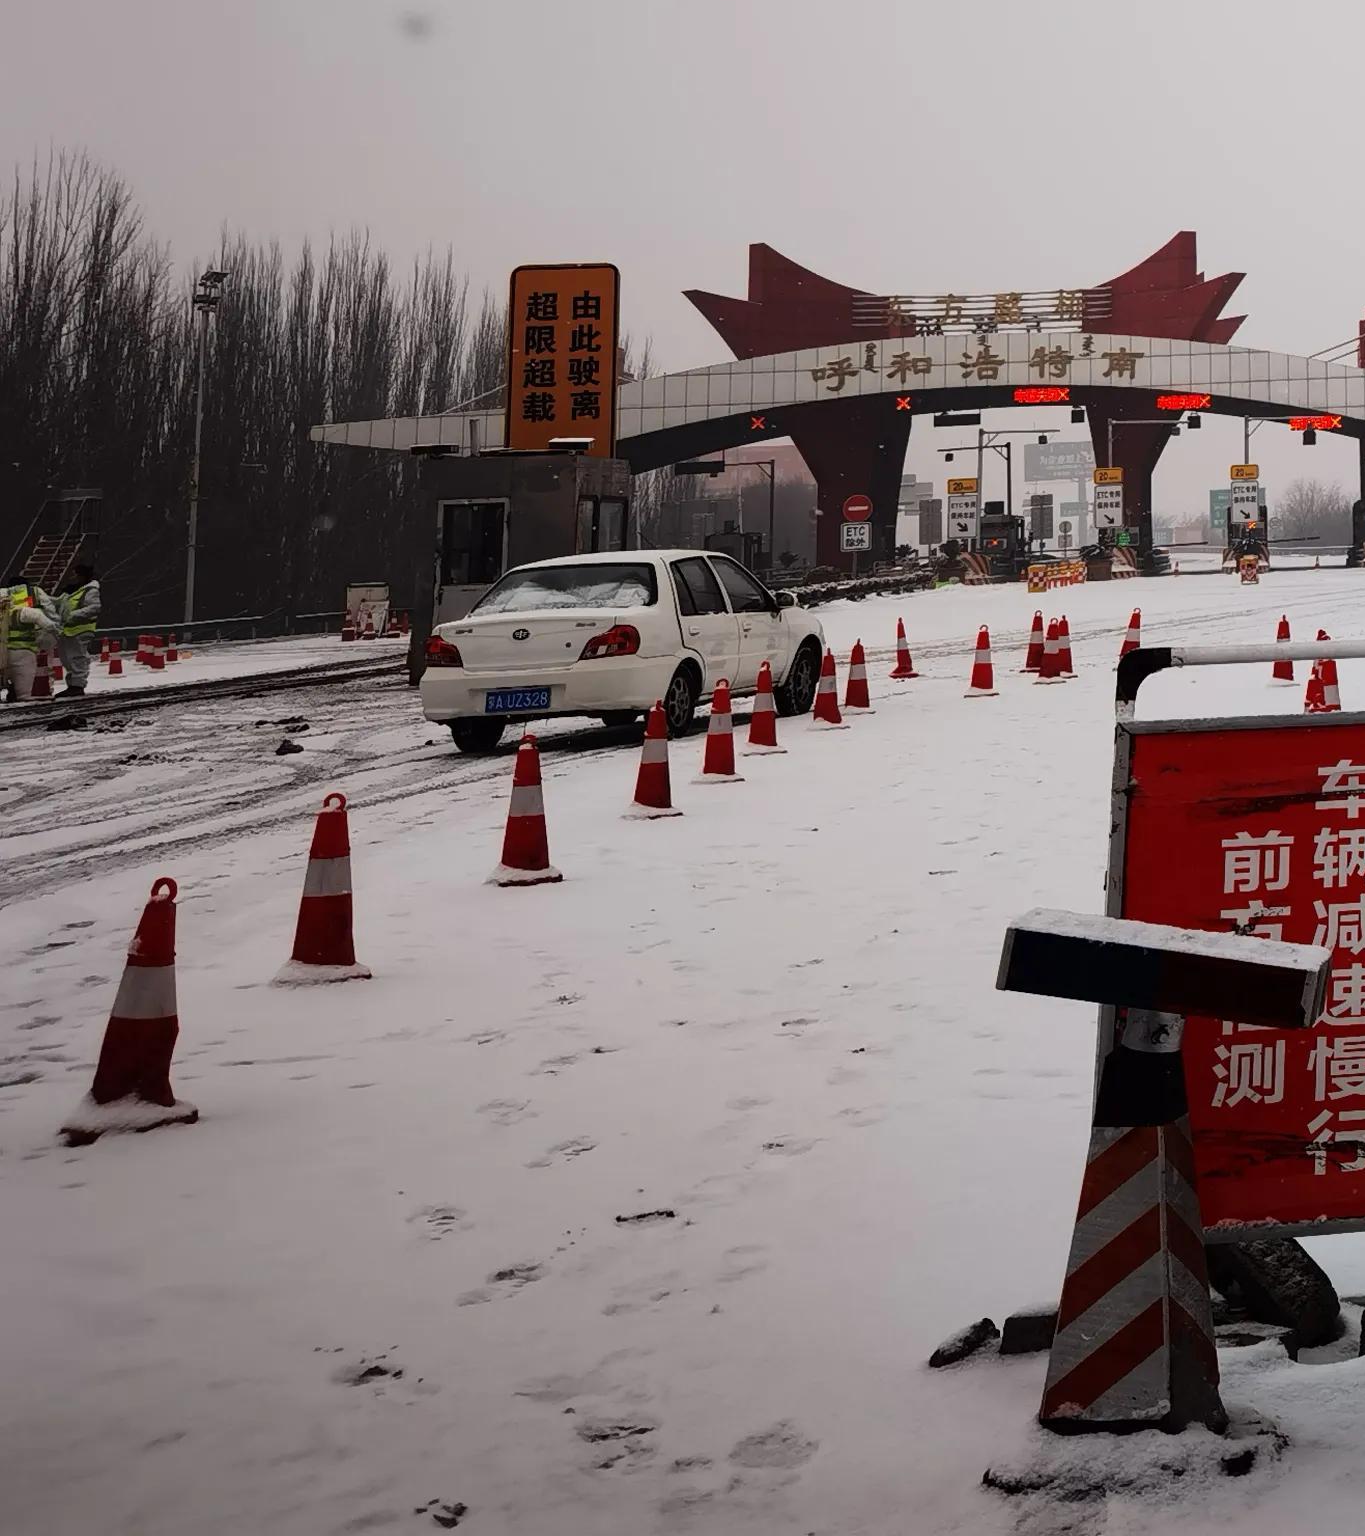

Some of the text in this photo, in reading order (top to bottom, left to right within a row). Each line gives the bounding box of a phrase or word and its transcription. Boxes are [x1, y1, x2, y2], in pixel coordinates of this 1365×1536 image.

[522, 292, 558, 422] 超限超载
[567, 290, 601, 420] 由此驶离
[812, 345, 1144, 392] 呼和浩特南
[846, 526, 865, 537] ETC
[1211, 830, 1295, 1108] 前方测
